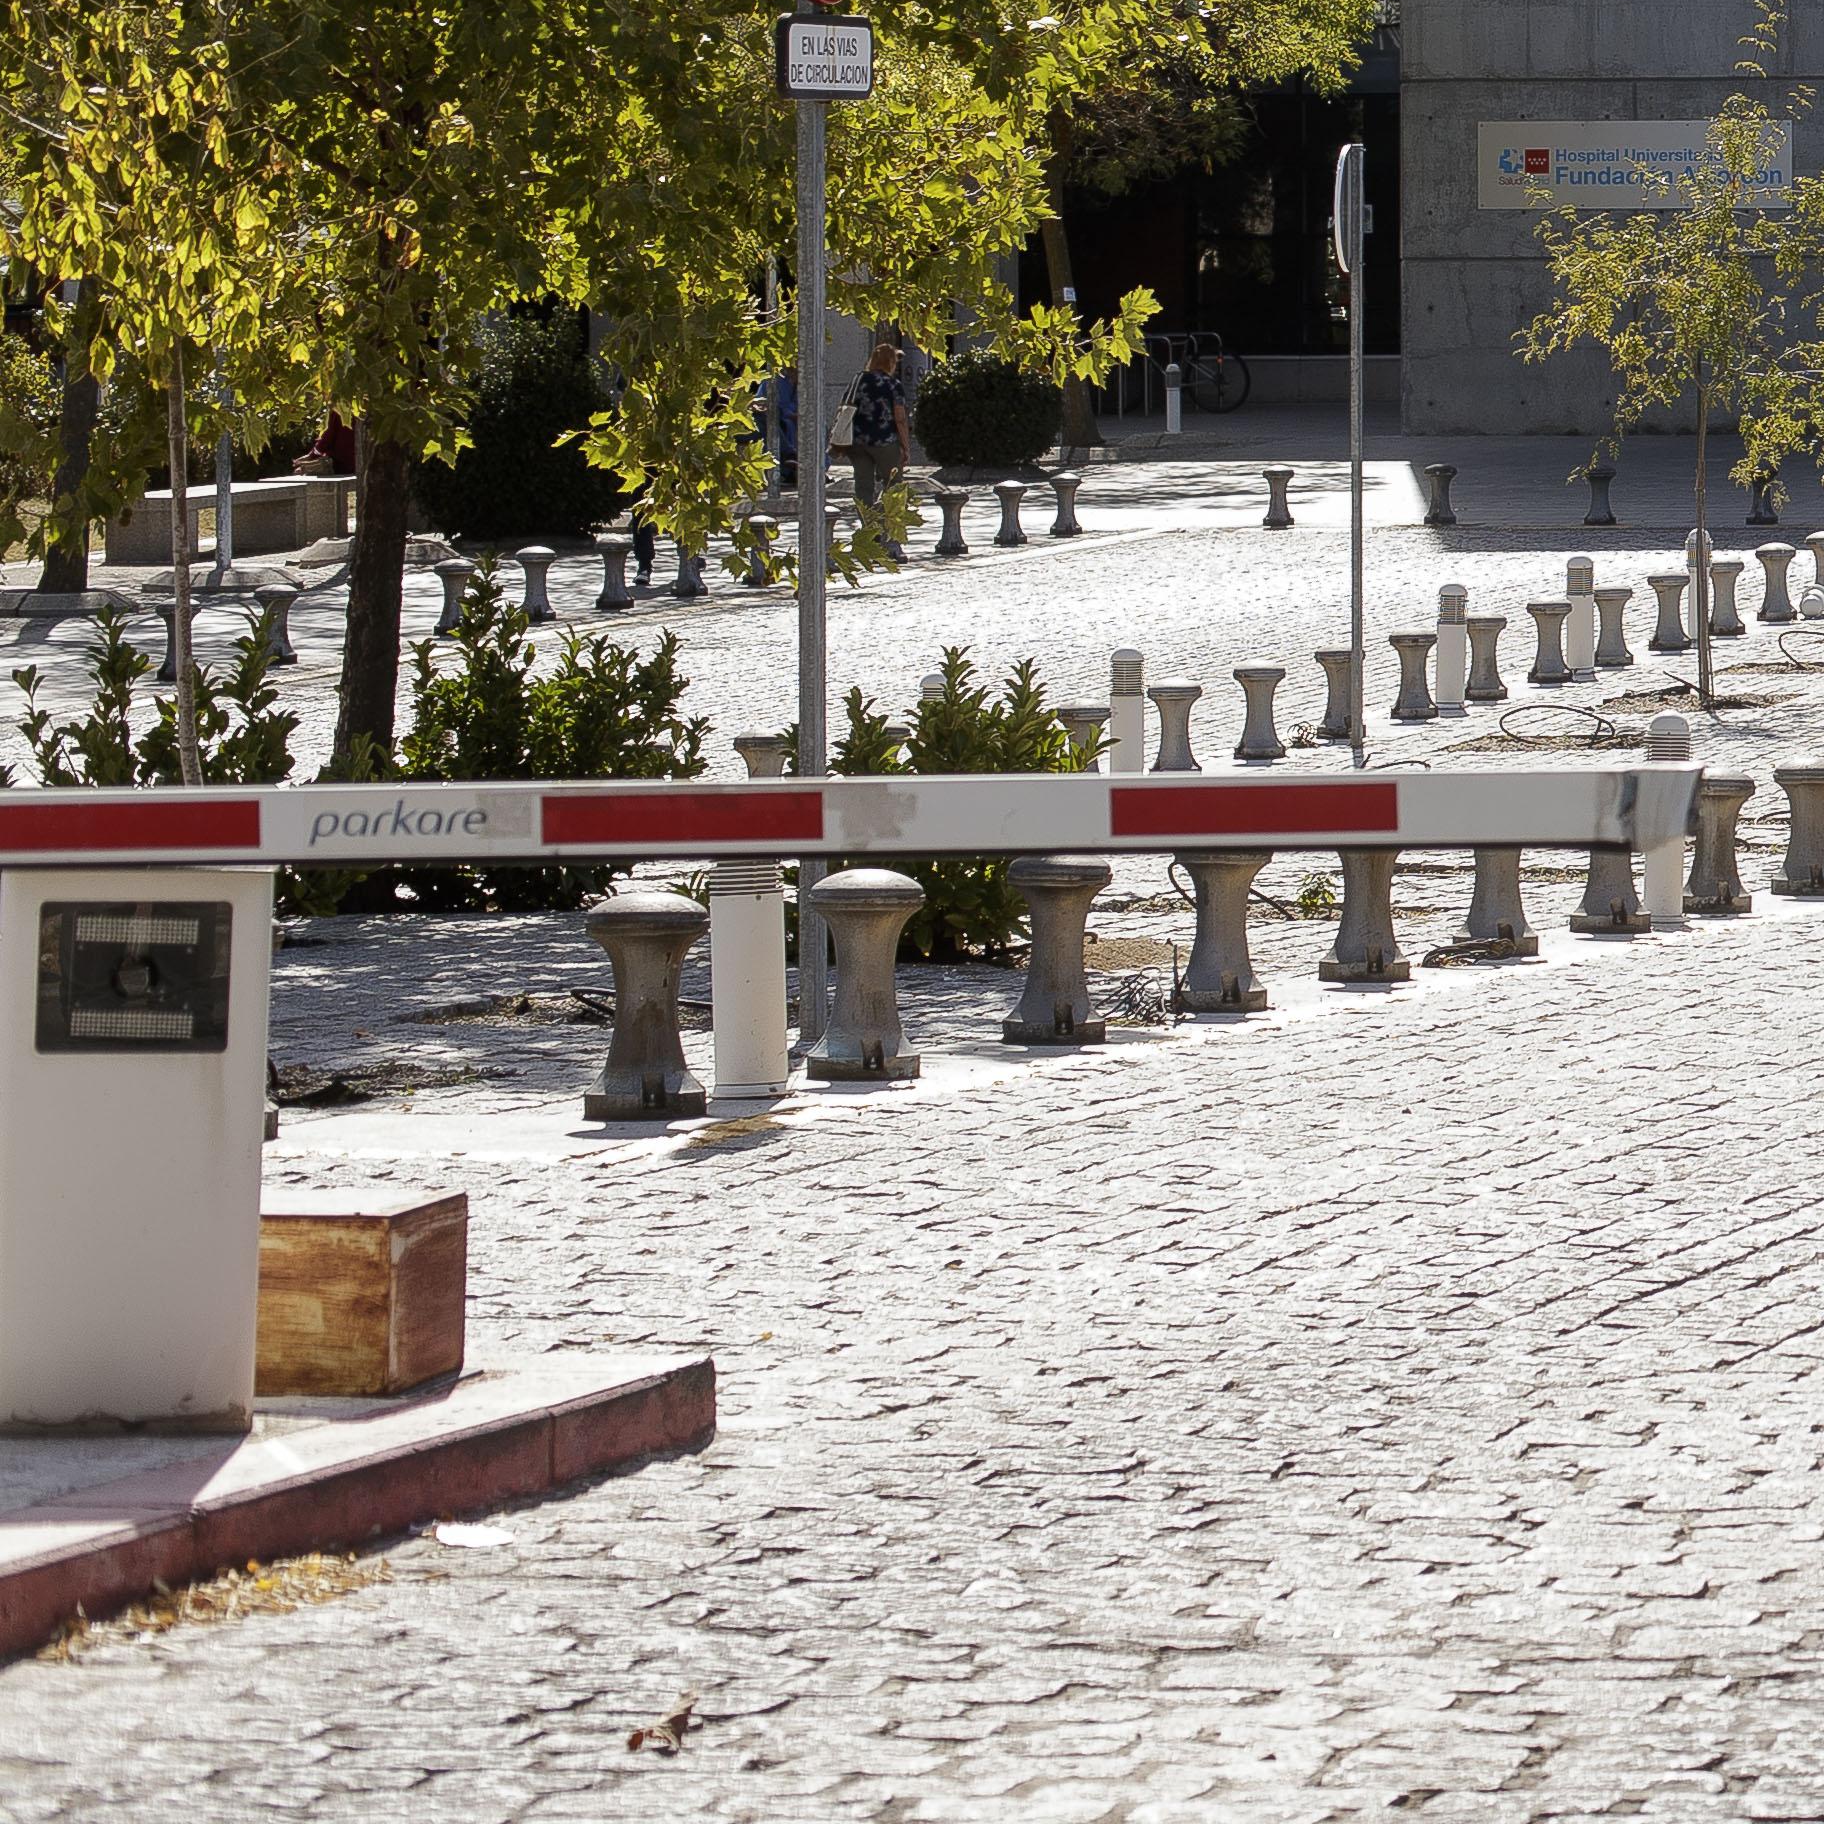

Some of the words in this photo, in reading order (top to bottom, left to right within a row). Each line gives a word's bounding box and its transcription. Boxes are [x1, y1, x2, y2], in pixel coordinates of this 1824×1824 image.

[801, 36, 815, 55] EN
[817, 37, 836, 56] LAS
[837, 37, 858, 57] VIAS
[790, 63, 804, 83] DE
[1554, 147, 1620, 165] Hospital
[308, 799, 488, 847] parkare
